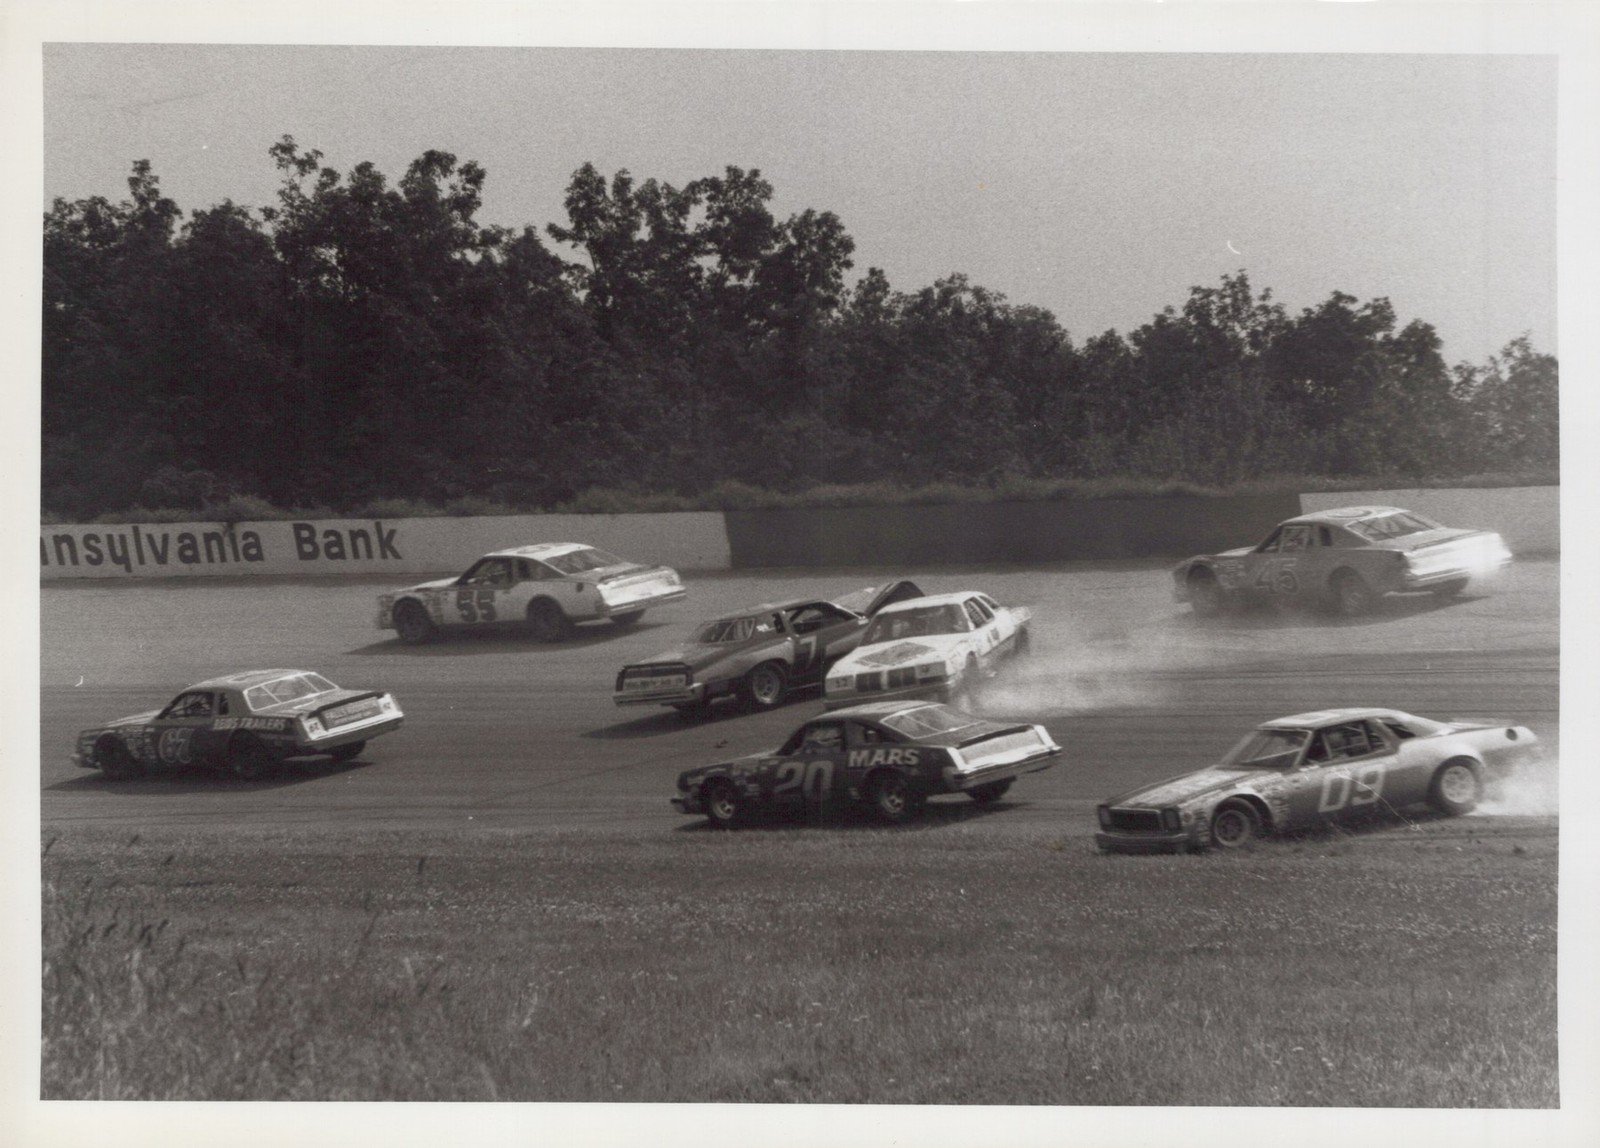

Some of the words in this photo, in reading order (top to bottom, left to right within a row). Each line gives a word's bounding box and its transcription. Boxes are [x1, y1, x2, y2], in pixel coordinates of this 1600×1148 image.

[292, 521, 403, 561] Bank
[456, 590, 498, 622] 55
[239, 717, 286, 731] TRAILERS
[158, 727, 195, 764] 67
[848, 748, 920, 769] MARS
[773, 760, 834, 801] 20
[1318, 764, 1385, 812] 09
